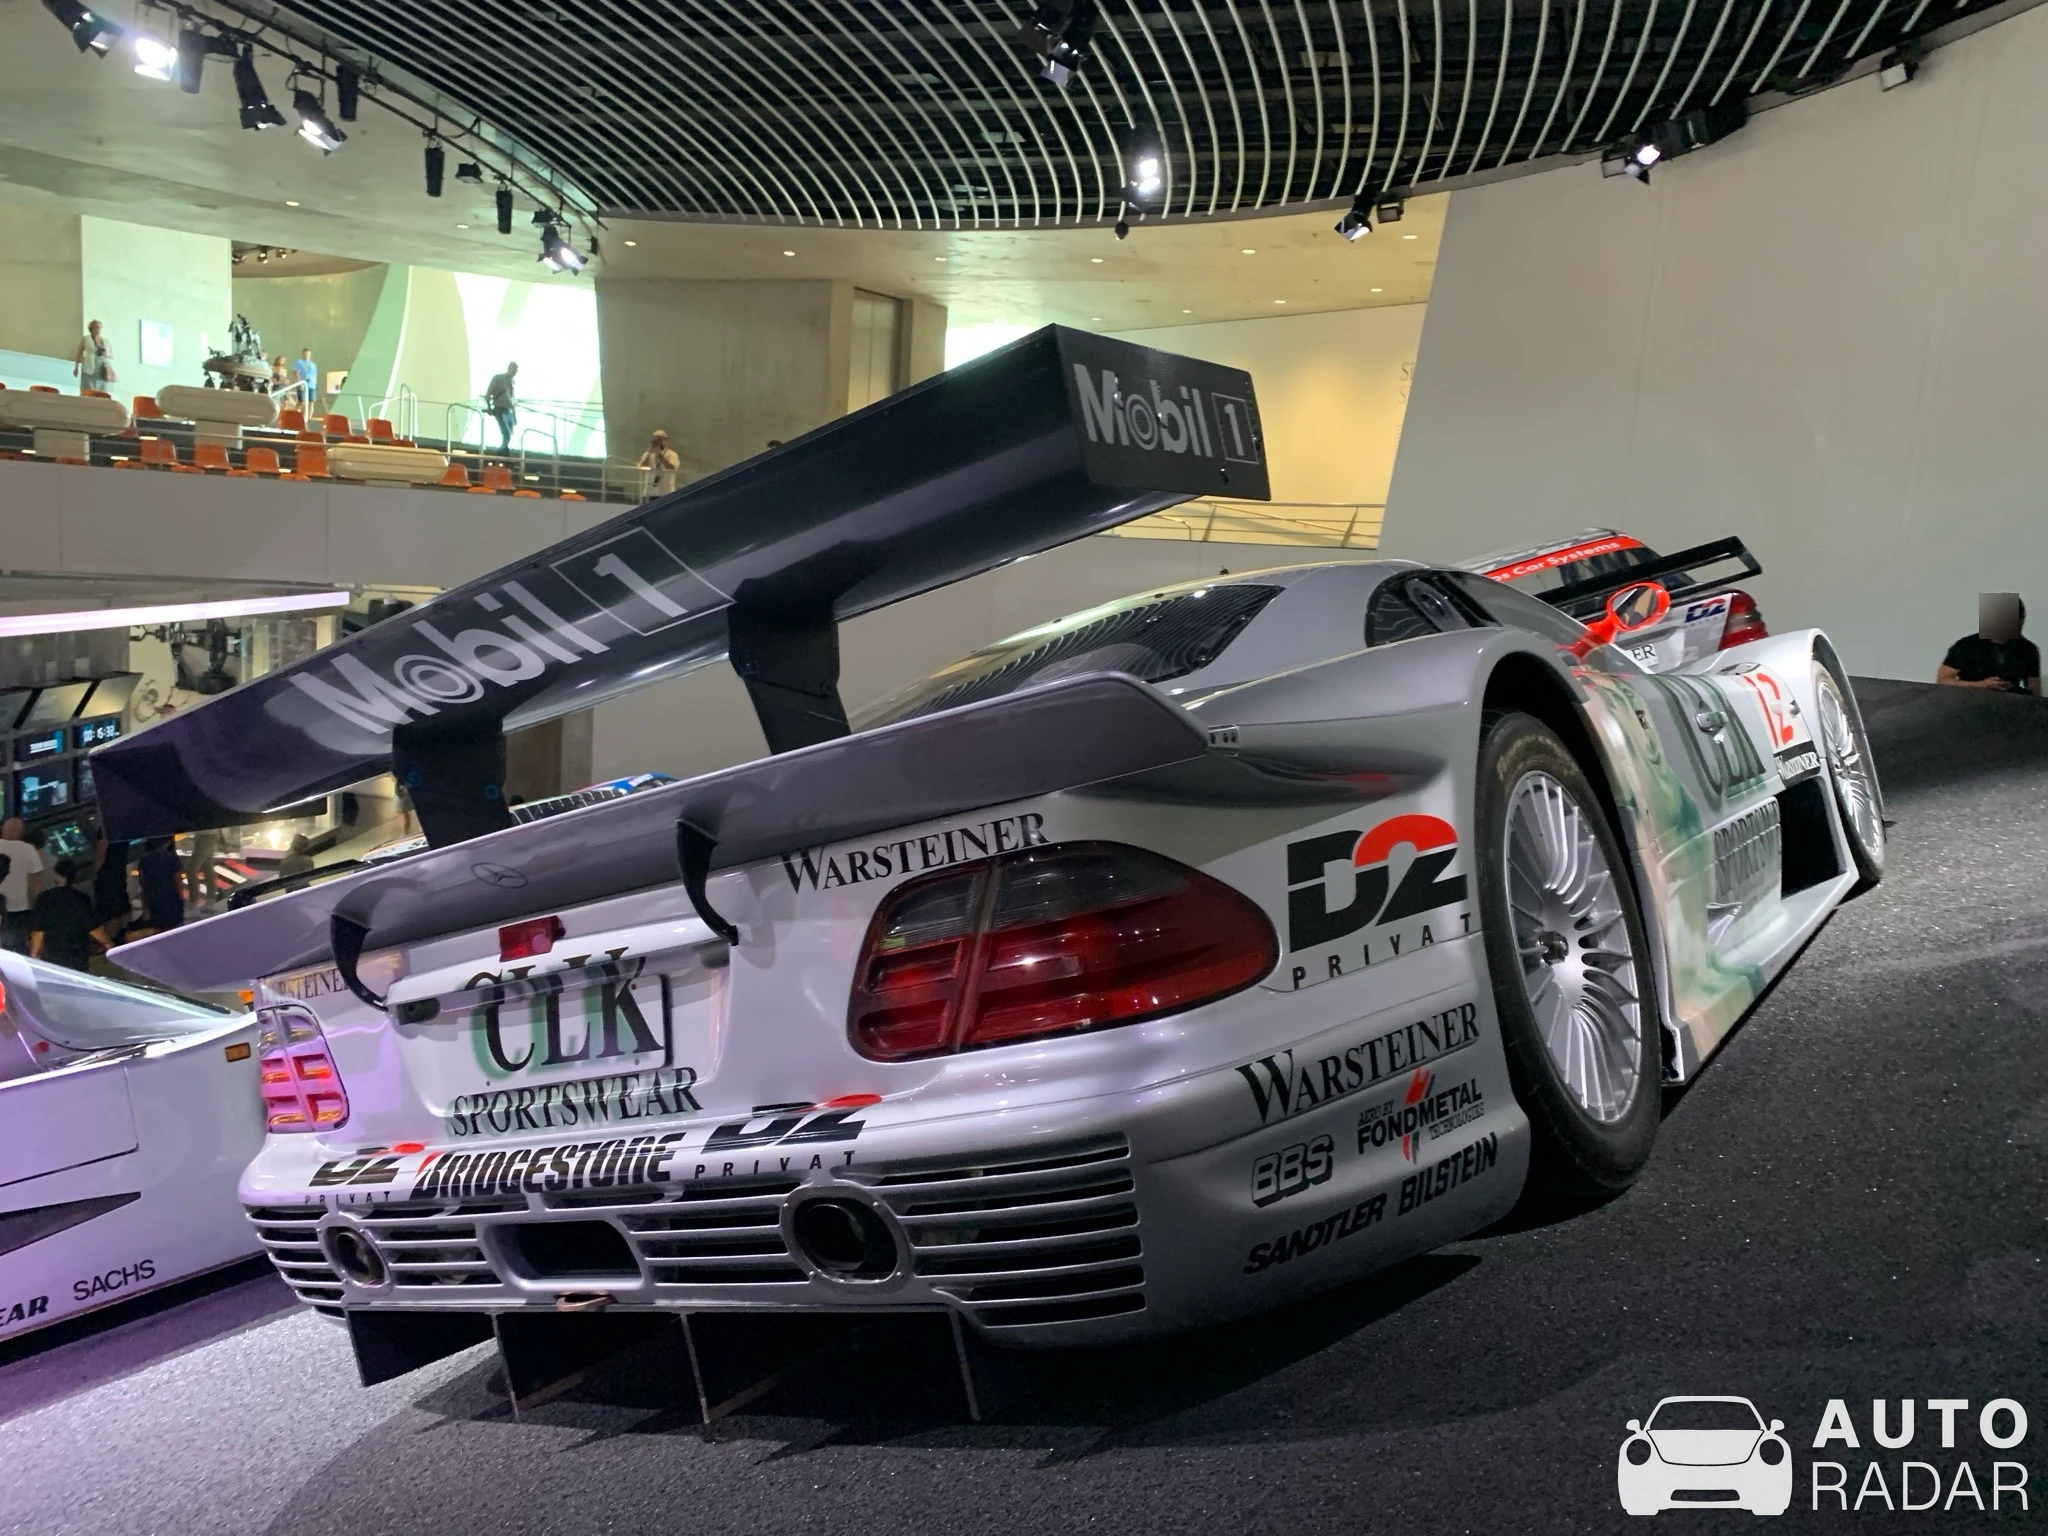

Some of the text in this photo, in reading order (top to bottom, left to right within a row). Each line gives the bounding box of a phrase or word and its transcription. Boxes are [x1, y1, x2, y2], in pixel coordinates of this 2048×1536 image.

[1073, 363, 1245, 458] Mobil 1
[1513, 561, 1545, 575] Car
[1547, 541, 1620, 568] Systems
[289, 553, 689, 735] Mobil 1
[780, 812, 1050, 895] WARSTEINER
[1287, 813, 1469, 953] D2
[1292, 912, 1471, 991] PRIVAT
[464, 946, 666, 1074] CLK
[450, 1066, 704, 1136] SPORTSWEAR
[1235, 1002, 1480, 1124] WARSTEINER
[1357, 1078, 1483, 1155] FONDMETAL
[304, 1190, 393, 1205] PRIVAT
[409, 1132, 687, 1201] BRIDGESTONE
[694, 1150, 856, 1180] PRIVAT
[1251, 1134, 1335, 1209] BBS
[1398, 1131, 1498, 1217] BILSTEIN
[1243, 1193, 1388, 1275] SANDTLER
[73, 1259, 156, 1301] SACHS
